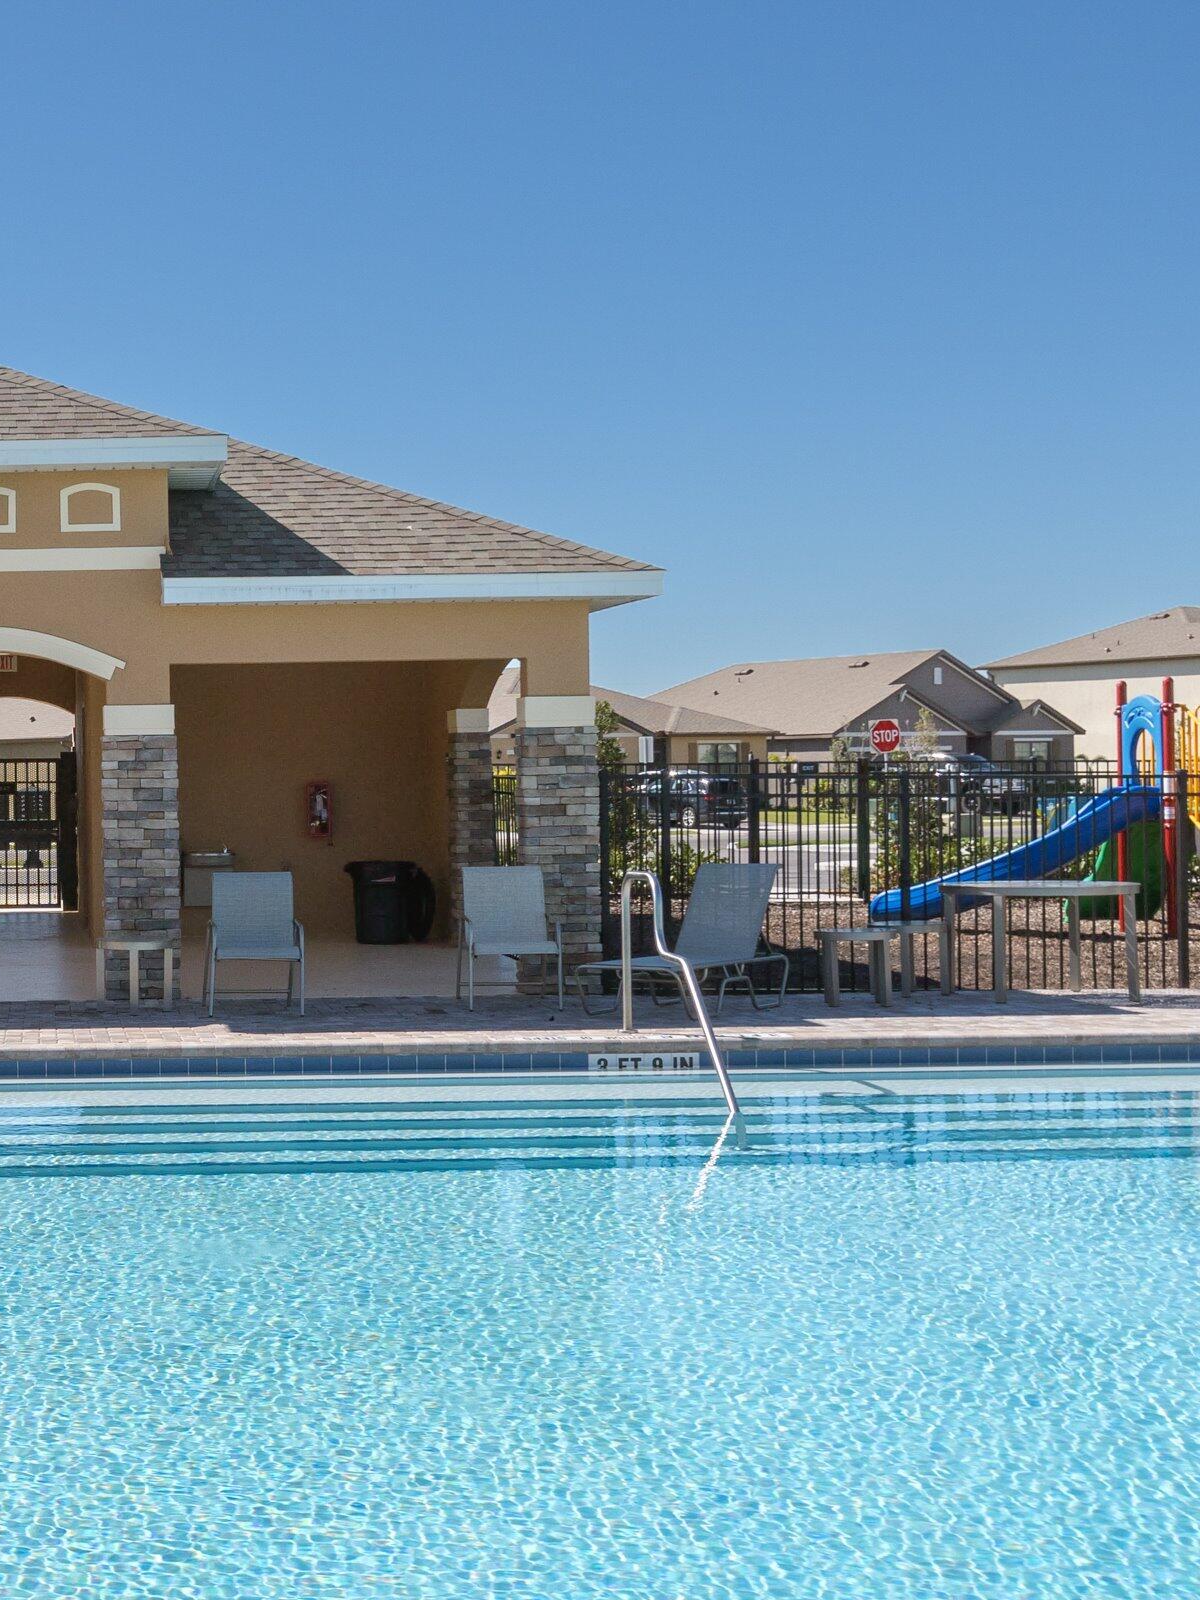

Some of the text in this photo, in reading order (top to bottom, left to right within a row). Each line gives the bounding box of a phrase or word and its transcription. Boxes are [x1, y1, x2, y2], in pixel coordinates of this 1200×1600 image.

[873, 730, 899, 743] STOP
[618, 1058, 642, 1069] FT
[673, 1056, 694, 1069] IN
